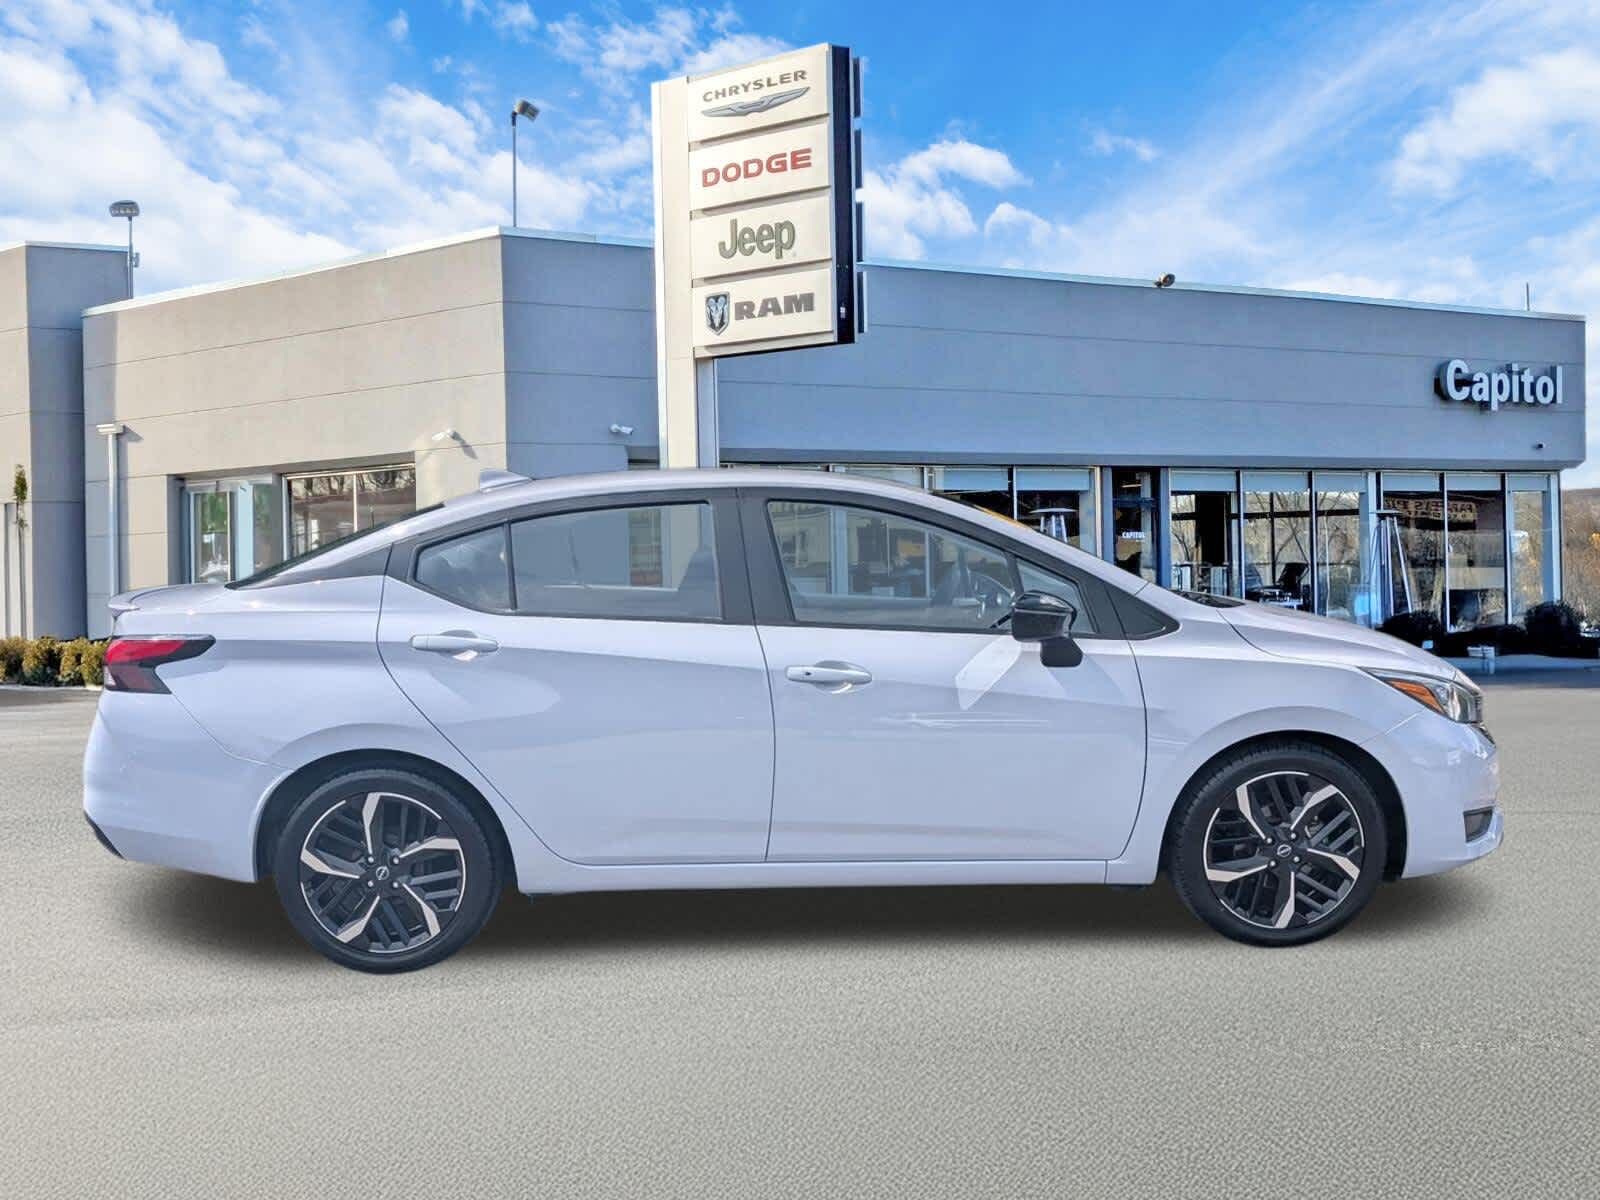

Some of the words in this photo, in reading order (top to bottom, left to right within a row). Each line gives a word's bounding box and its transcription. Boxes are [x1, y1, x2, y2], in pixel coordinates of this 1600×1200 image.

[702, 69, 807, 102] CHRYSLER
[702, 147, 812, 188] DODGE
[718, 218, 796, 260] Jeep
[734, 292, 815, 321] RAM
[1446, 359, 1563, 411] Capitol
